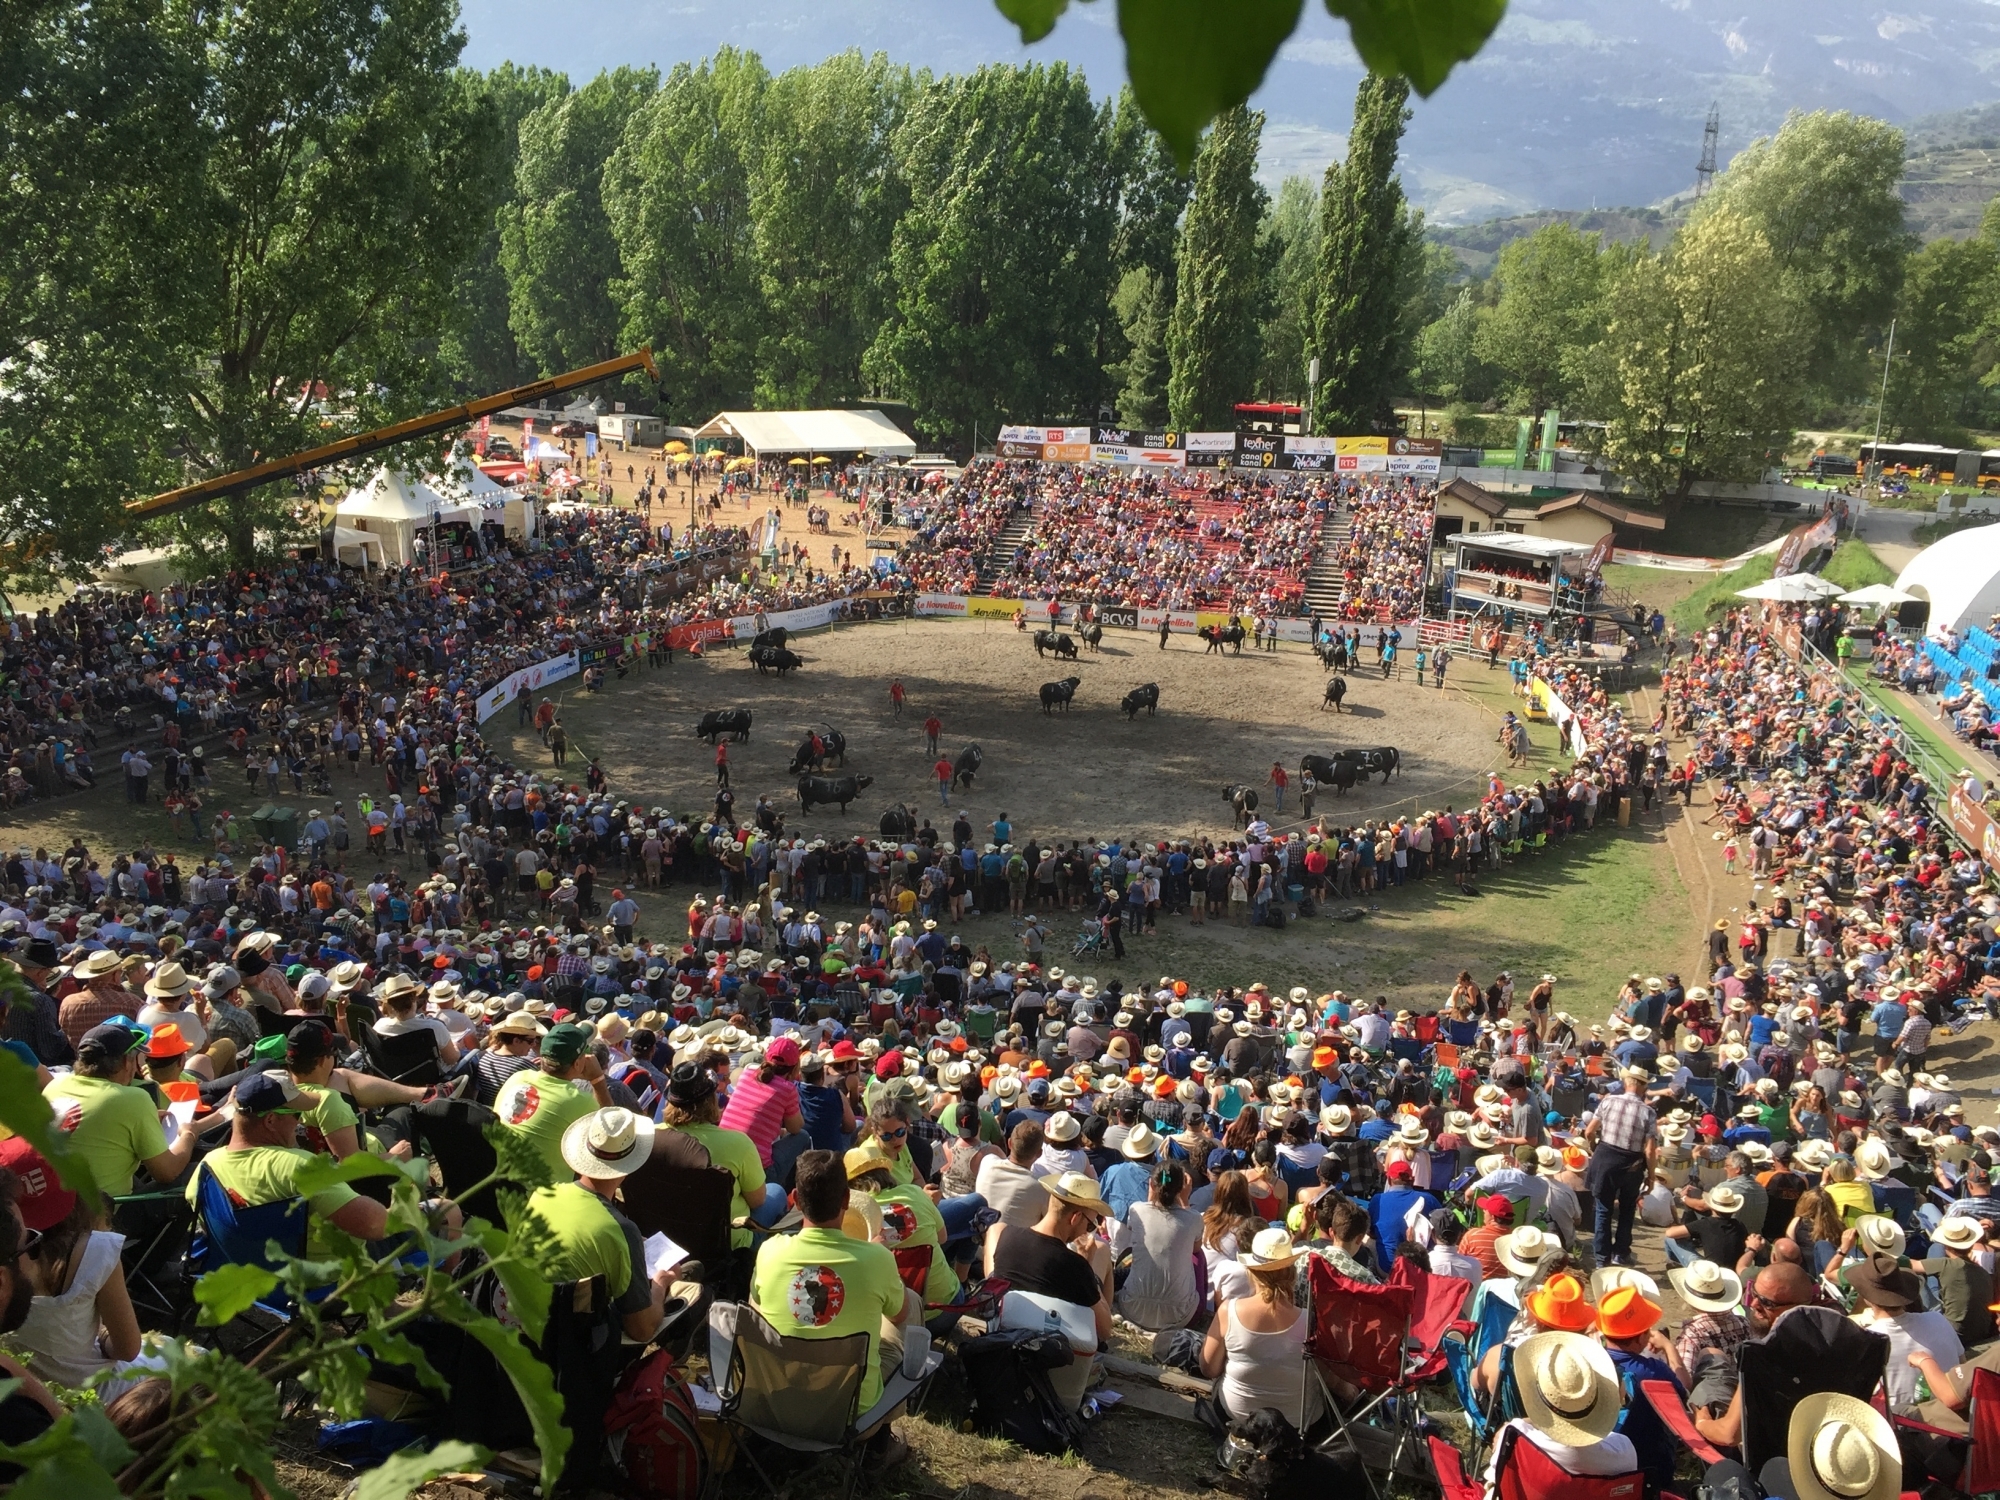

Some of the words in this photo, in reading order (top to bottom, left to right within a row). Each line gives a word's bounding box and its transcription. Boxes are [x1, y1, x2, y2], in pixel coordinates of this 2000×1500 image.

[1048, 432, 1063, 440] RTS
[1165, 433, 1176, 449] 9
[1096, 446, 1129, 456] PAPIVAL
[1263, 452, 1273, 467] 9
[1340, 459, 1356, 467] RTS
[1415, 463, 1437, 471] aproz
[916, 600, 925, 609] Le
[926, 600, 965, 611] Nouvelliste
[1101, 613, 1135, 626] BCVS
[1141, 616, 1150, 624] Le
[690, 626, 722, 640] Valais
[594, 648, 607, 660] BLA
[607, 646, 620, 656] BLO
[761, 648, 776, 660] 83
[716, 711, 736, 723] 42
[1360, 750, 1383, 765] 70
